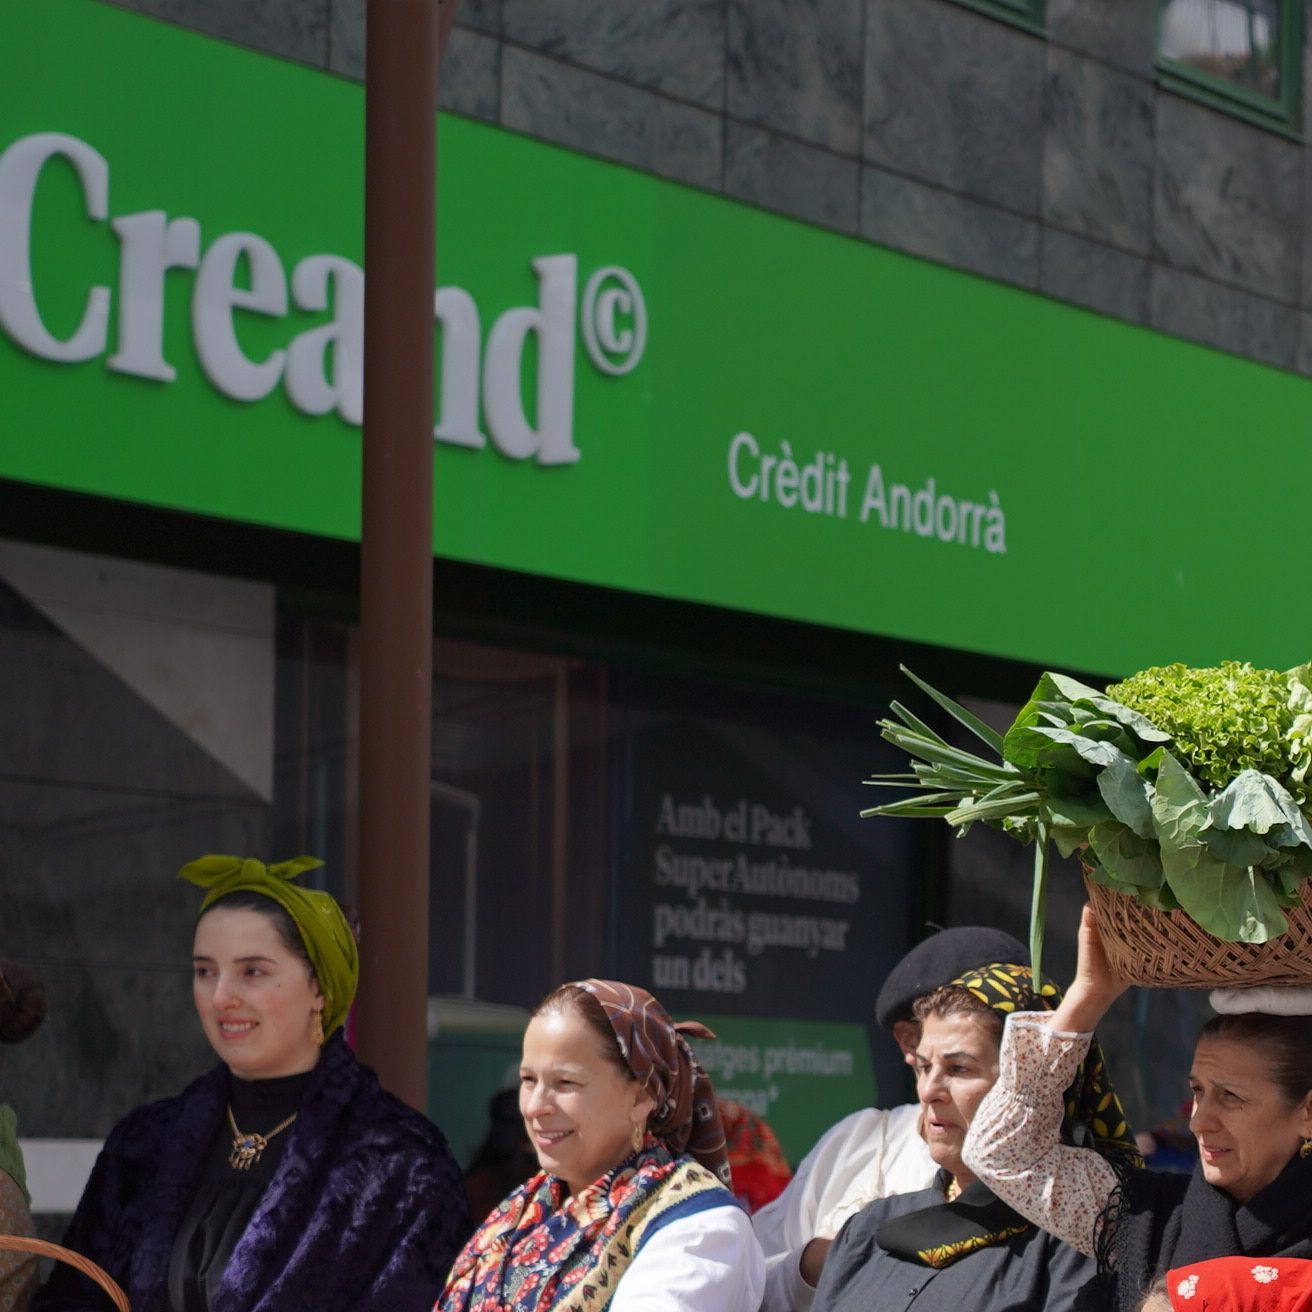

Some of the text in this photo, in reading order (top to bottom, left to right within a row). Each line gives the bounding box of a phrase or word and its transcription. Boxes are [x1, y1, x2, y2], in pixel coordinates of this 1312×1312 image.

[727, 432, 1007, 555] Crèdit Andorrà
[657, 792, 811, 850] Amb el Pack
[655, 845, 733, 900] Super
[747, 910, 850, 959] guanyar
[653, 946, 747, 993] un dels
